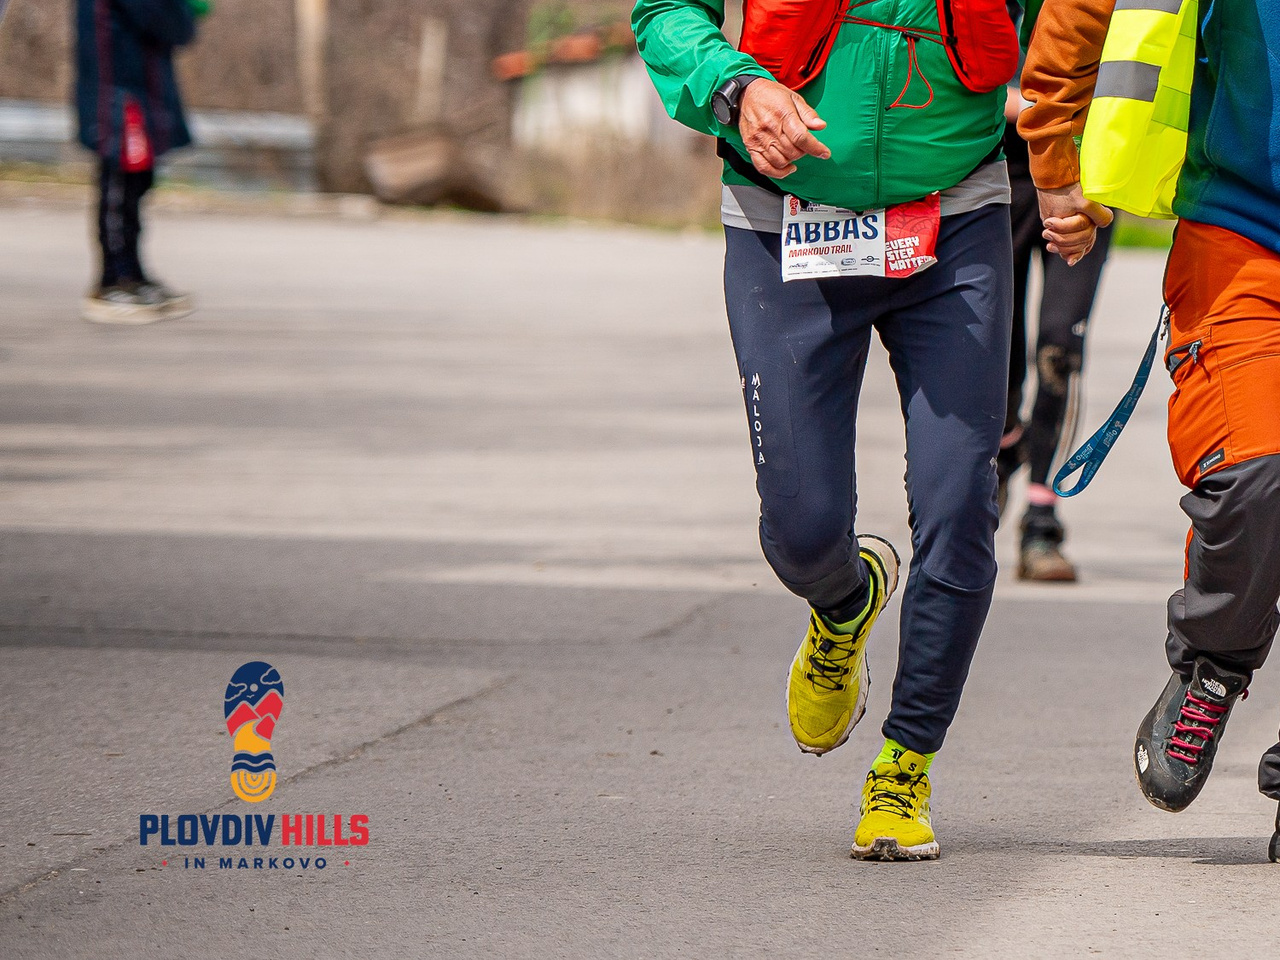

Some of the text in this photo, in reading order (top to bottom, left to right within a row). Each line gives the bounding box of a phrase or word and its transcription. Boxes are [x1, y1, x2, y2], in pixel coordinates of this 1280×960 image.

[785, 214, 879, 246] ABBAS
[788, 244, 853, 258] MARKOVO TRAIL
[885, 236, 920, 251] EVERY
[886, 248, 915, 261] STEP
[889, 255, 933, 271] MATTE
[751, 372, 766, 465] MALOJA
